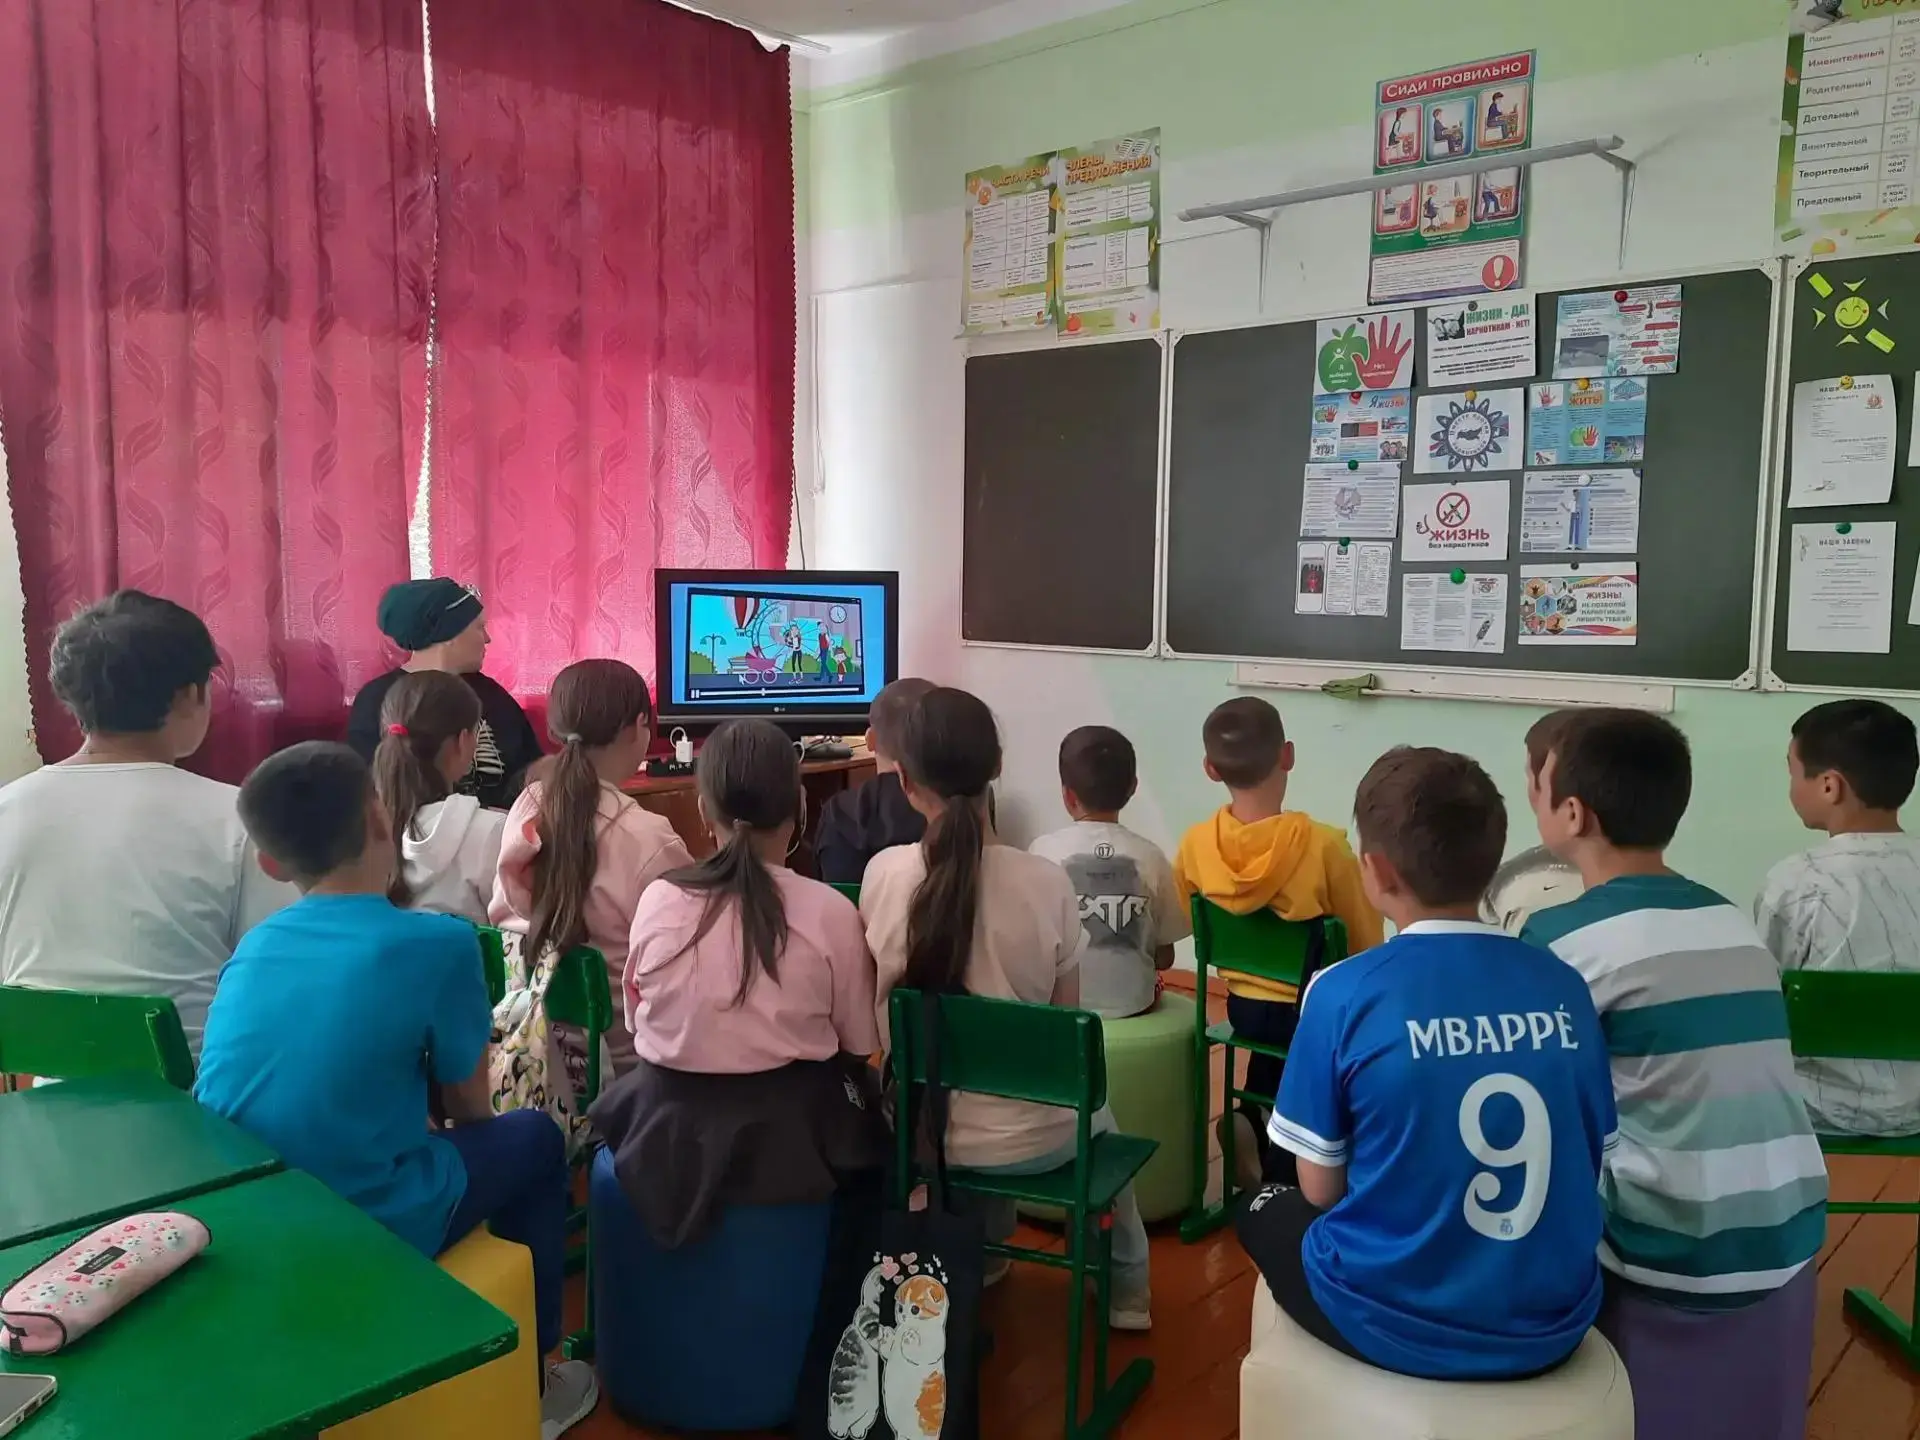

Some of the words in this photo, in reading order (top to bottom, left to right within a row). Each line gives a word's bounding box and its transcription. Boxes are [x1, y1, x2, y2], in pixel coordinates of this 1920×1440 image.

[1386, 80, 1427, 98] Сиди
[1432, 62, 1522, 88] правильно
[1065, 153, 1152, 185] ПРЕДЛОЖЕНИЯ
[1799, 163, 1869, 178] Творительный
[1797, 193, 1862, 208] Предложный
[1511, 303, 1529, 319] ДА!
[1428, 528, 1490, 541] ЖИЗНЬ
[1405, 1003, 1579, 1059] MBAPPÉ
[1458, 1072, 1552, 1241] 9
